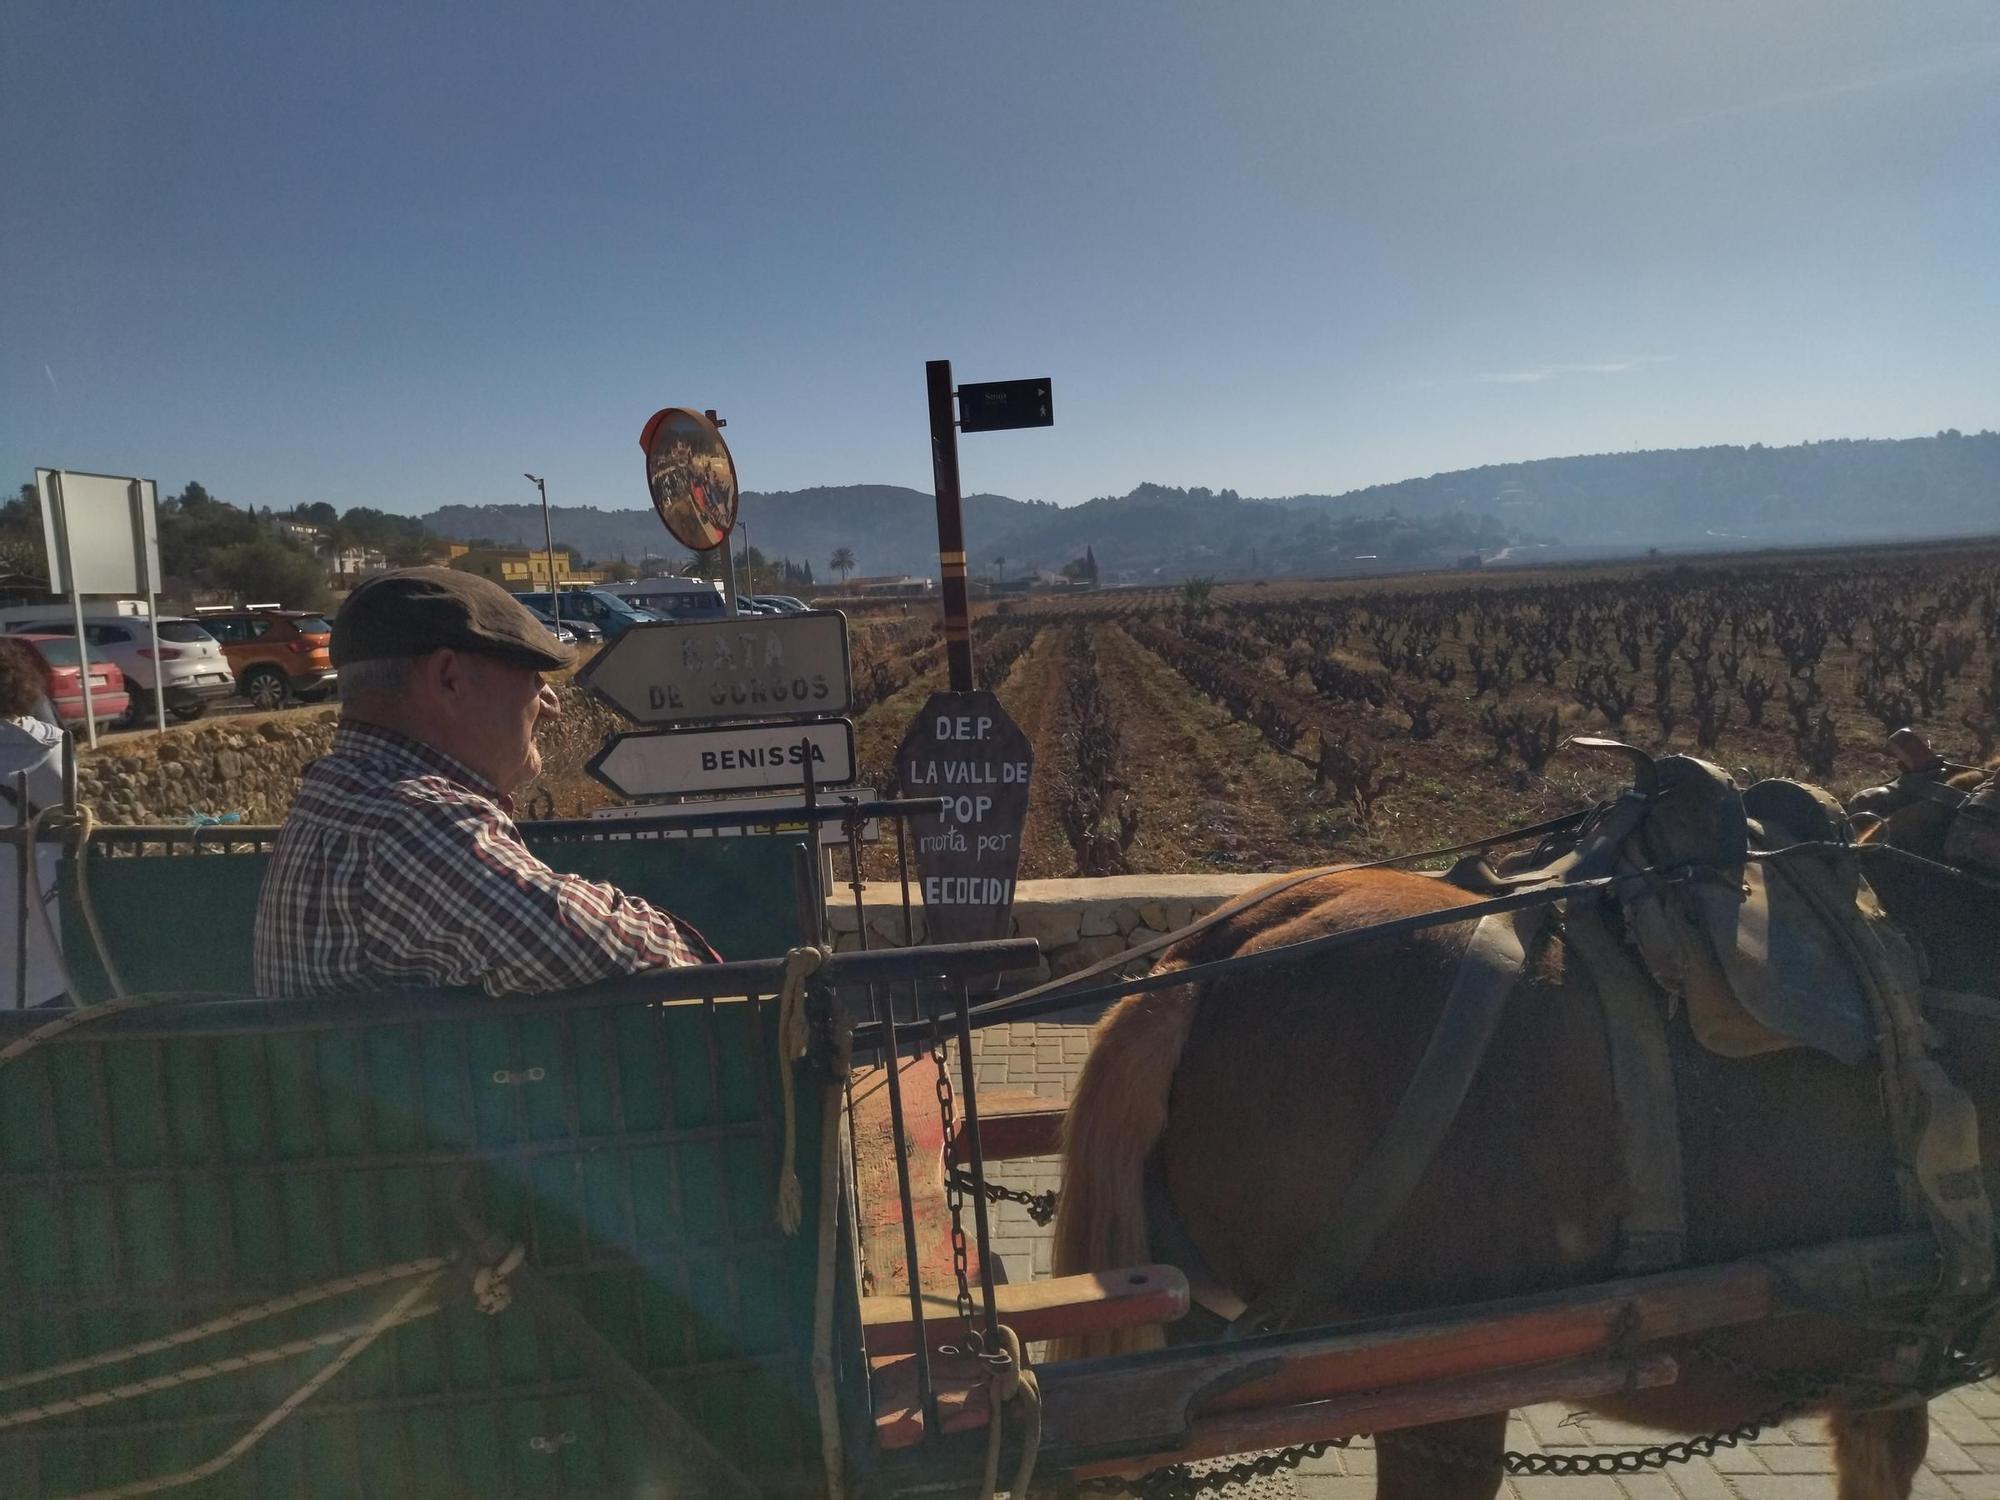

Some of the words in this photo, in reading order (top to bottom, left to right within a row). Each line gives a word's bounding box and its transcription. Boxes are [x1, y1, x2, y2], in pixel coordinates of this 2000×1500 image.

[649, 685, 684, 710] DE
[936, 716, 992, 740] D.E.P.
[701, 744, 825, 771] BENISSA
[911, 760, 938, 784] LA
[944, 761, 997, 784] VALL
[1003, 762, 1028, 784] DE
[939, 796, 992, 823] POP
[920, 825, 967, 854] morta
[977, 833, 1014, 862] per
[926, 877, 1010, 905] ECOCIDI
